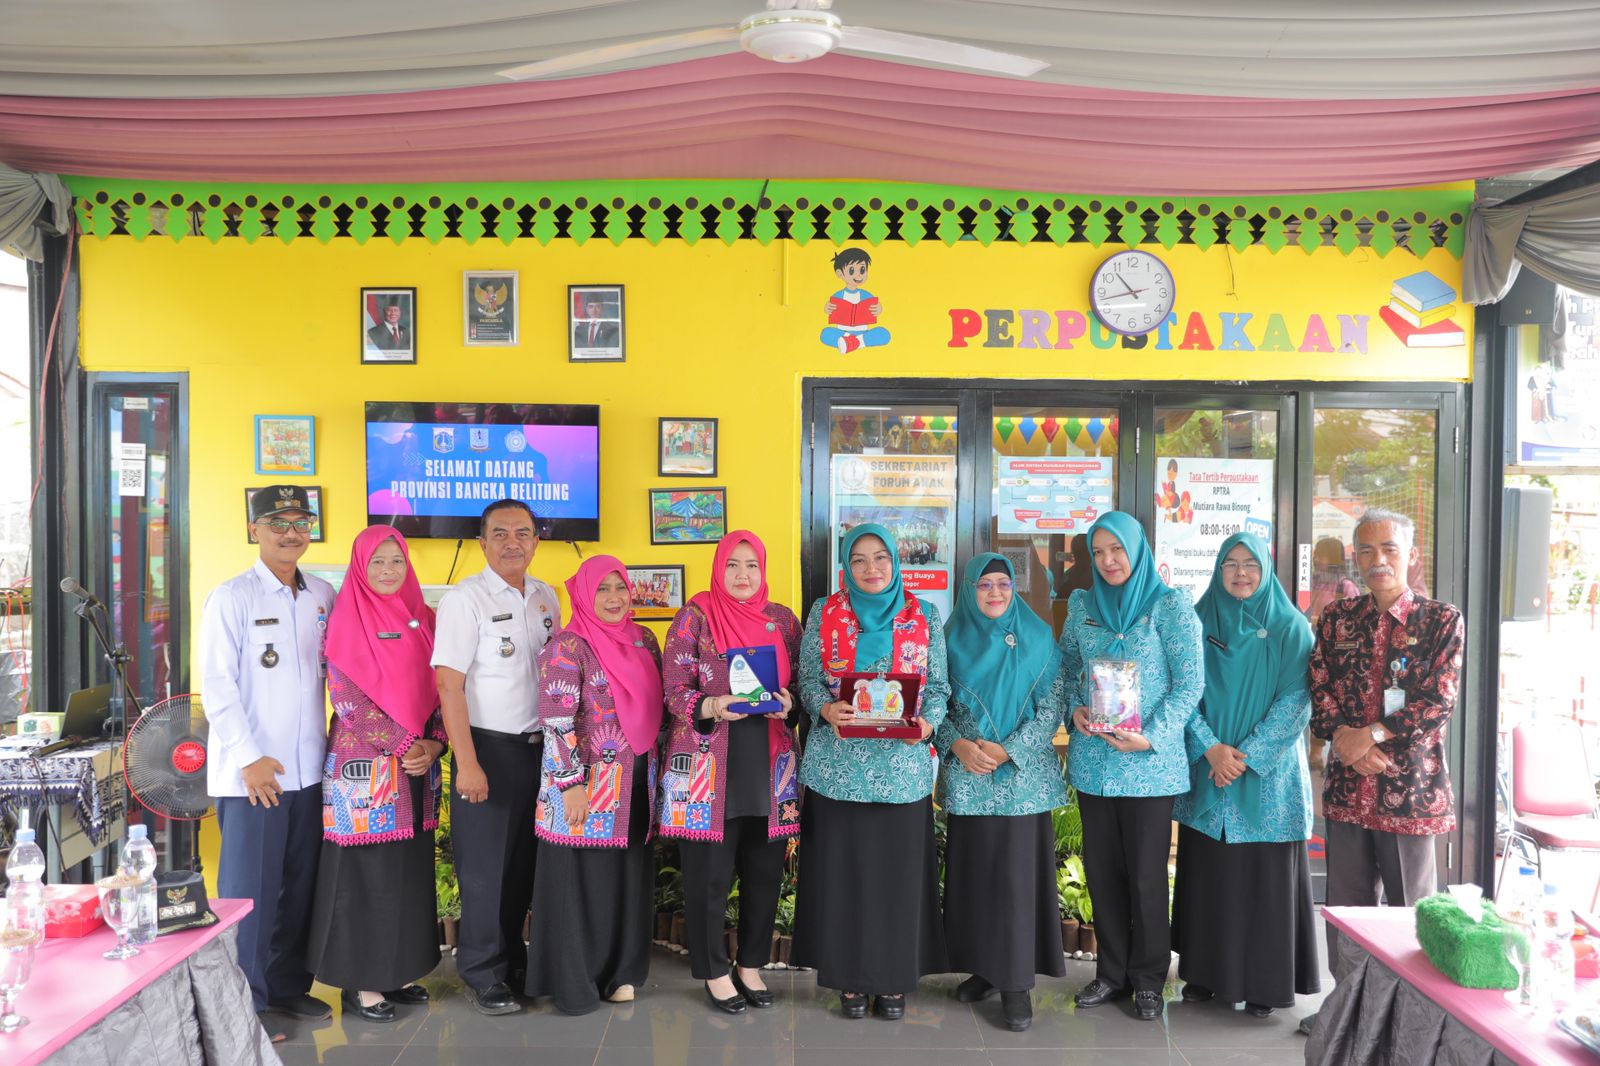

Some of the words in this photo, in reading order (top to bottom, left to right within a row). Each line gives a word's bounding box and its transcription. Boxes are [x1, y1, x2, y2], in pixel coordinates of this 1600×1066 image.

[1113, 262, 1121, 272] 11
[1127, 256, 1139, 269] 12
[1146, 262, 1150, 272] 1
[1102, 272, 1115, 284] 10
[1154, 272, 1163, 284] 2
[1097, 287, 1106, 298] 9
[1159, 287, 1168, 299] 3
[1153, 303, 1164, 314] 4
[1112, 313, 1121, 324] 7
[1127, 317, 1137, 329] 6
[1143, 313, 1152, 324] 5
[425, 460, 480, 478] SELAMAT
[485, 461, 534, 479] DATANG
[871, 461, 947, 472] SEKRETARIAT
[873, 477, 910, 488] FORUM
[913, 477, 944, 488] ANAK
[1189, 472, 1201, 480] Tata
[1202, 472, 1219, 481] Tertib
[1220, 472, 1259, 482] Perpustakaan
[391, 481, 451, 499] PROVINSI
[455, 482, 506, 500] BANGKA
[510, 483, 569, 501] BELITUNG
[1212, 486, 1230, 495] RPTRA
[1193, 501, 1215, 511] Mutiara
[1216, 502, 1230, 511] Rawa
[1232, 502, 1251, 514] Binong
[1200, 524, 1240, 536] 08:00-16:00
[1246, 521, 1270, 540] OPEN
[914, 572, 935, 580] Buaya
[1173, 567, 1194, 578] Dilarang
